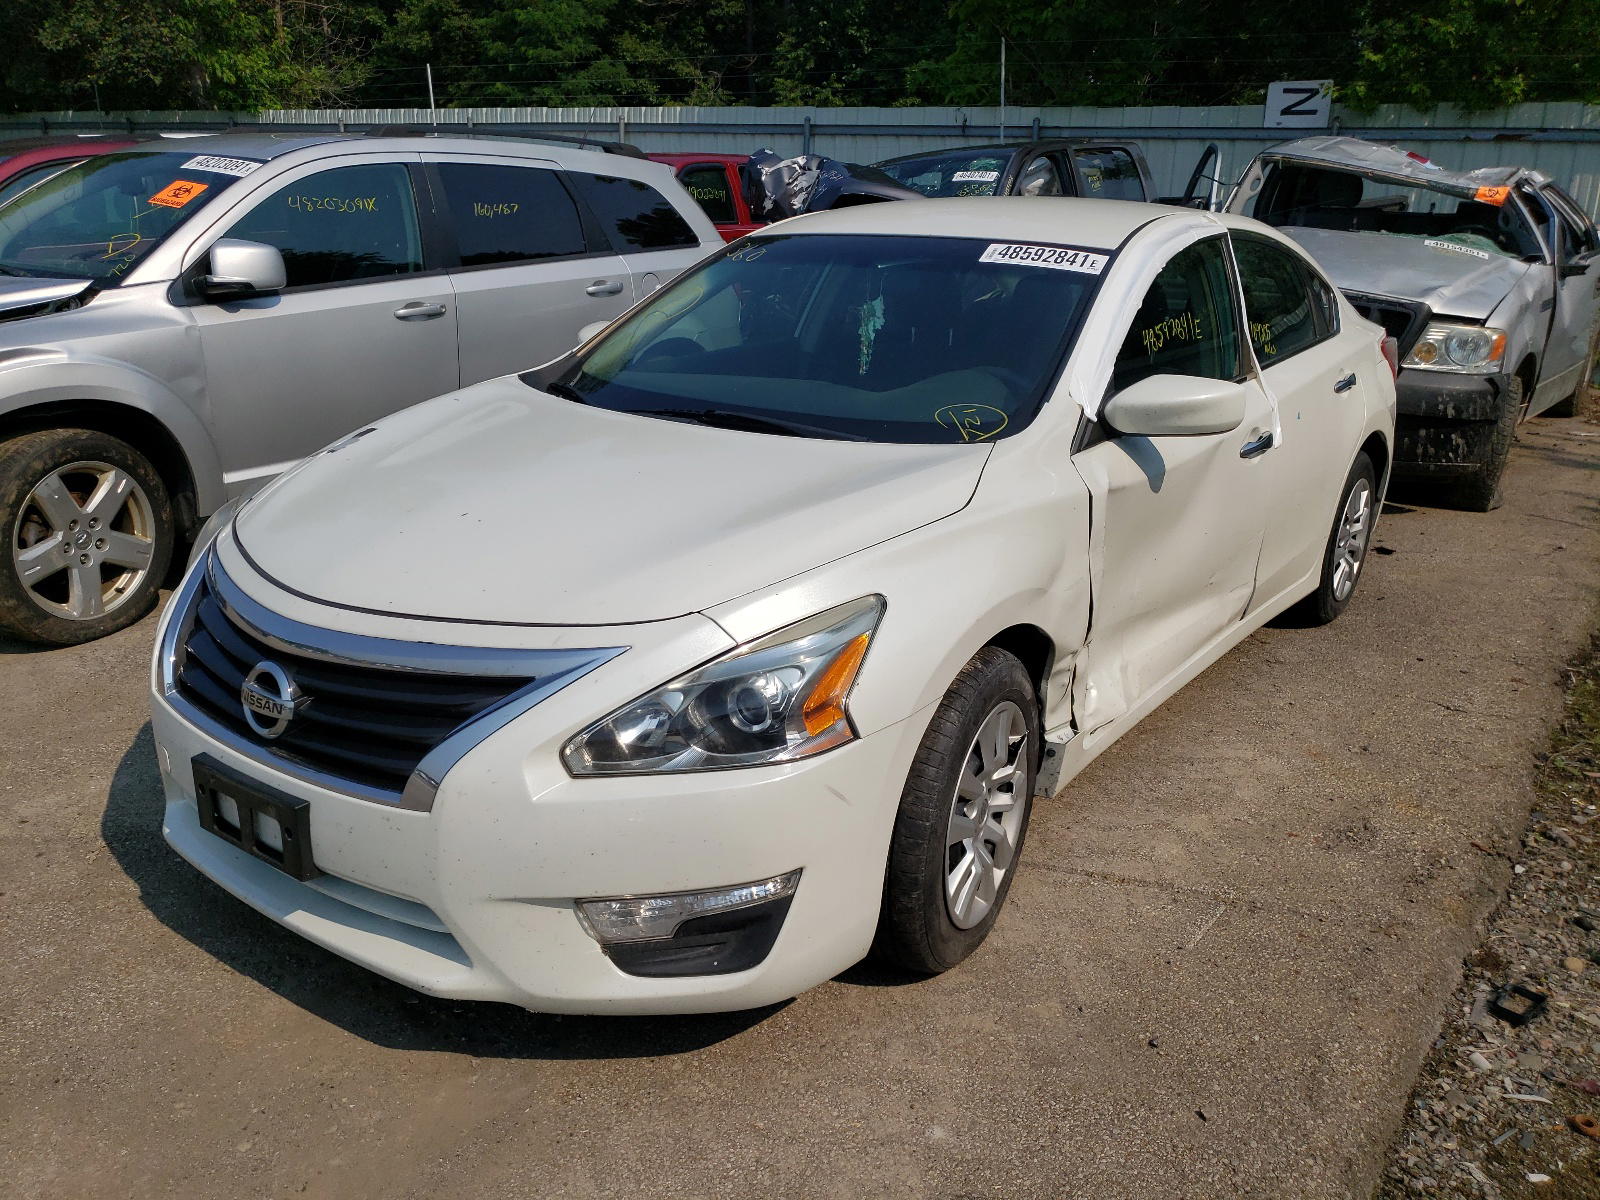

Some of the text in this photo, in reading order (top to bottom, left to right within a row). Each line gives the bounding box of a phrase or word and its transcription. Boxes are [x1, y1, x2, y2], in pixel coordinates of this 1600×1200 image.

[196, 157, 250, 173] 48203091
[998, 246, 1090, 268] 48592841
[1089, 259, 1100, 268] E
[242, 688, 285, 715] NISSAN
